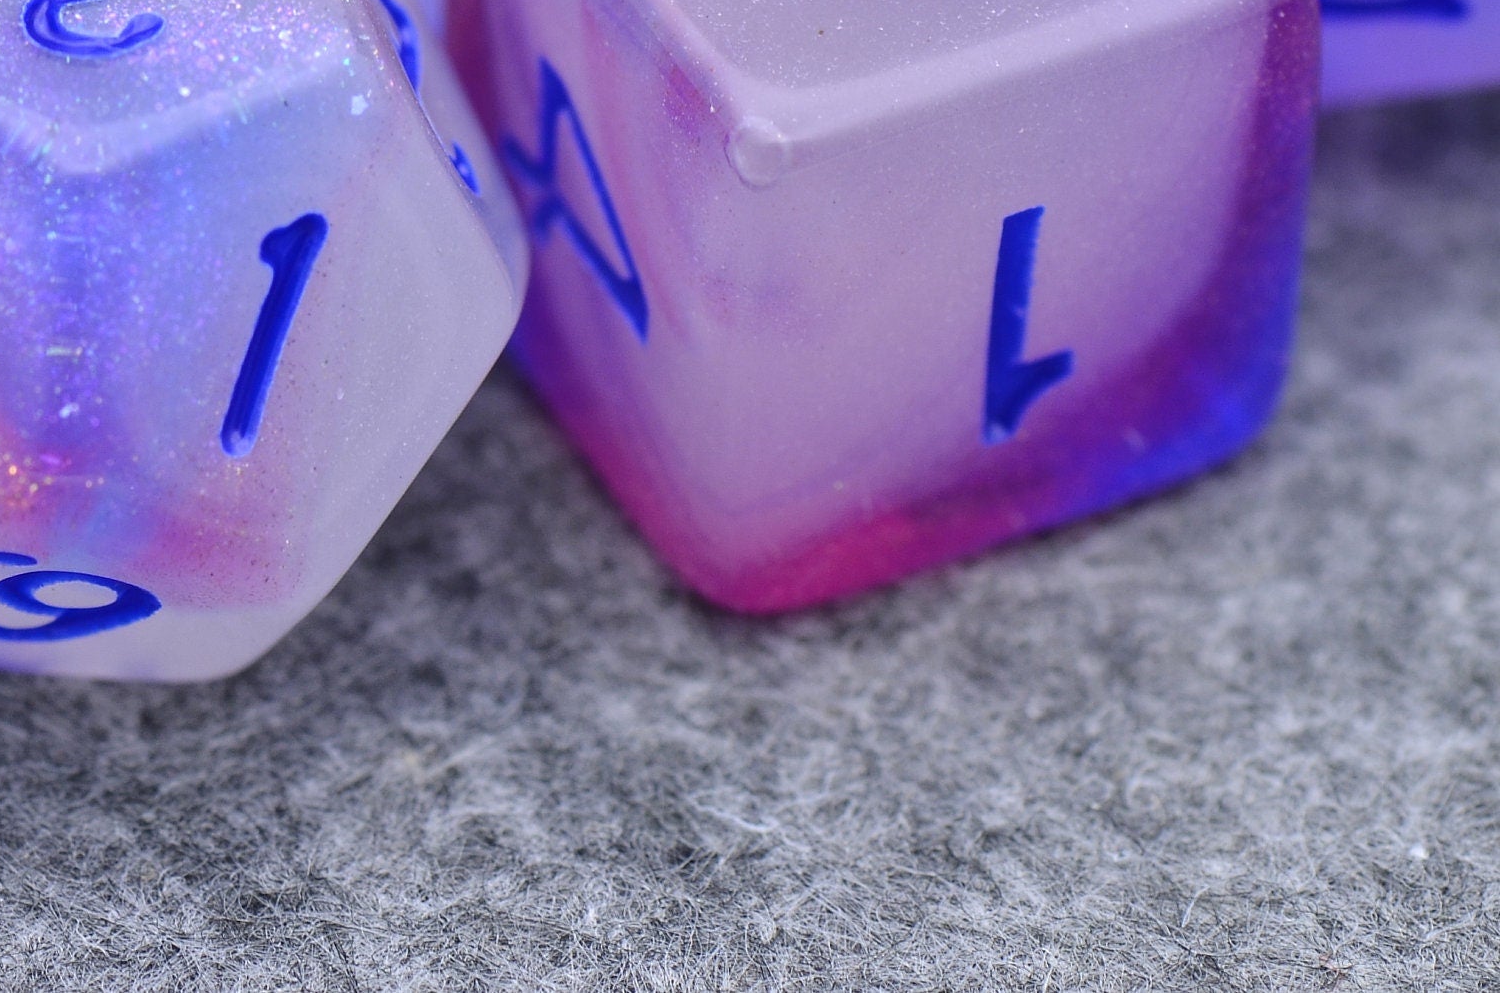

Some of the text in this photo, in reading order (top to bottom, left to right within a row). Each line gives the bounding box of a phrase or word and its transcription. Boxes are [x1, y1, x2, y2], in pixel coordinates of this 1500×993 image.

[502, 56, 650, 348] 4
[219, 212, 331, 459] 1
[982, 206, 1076, 448] 1
